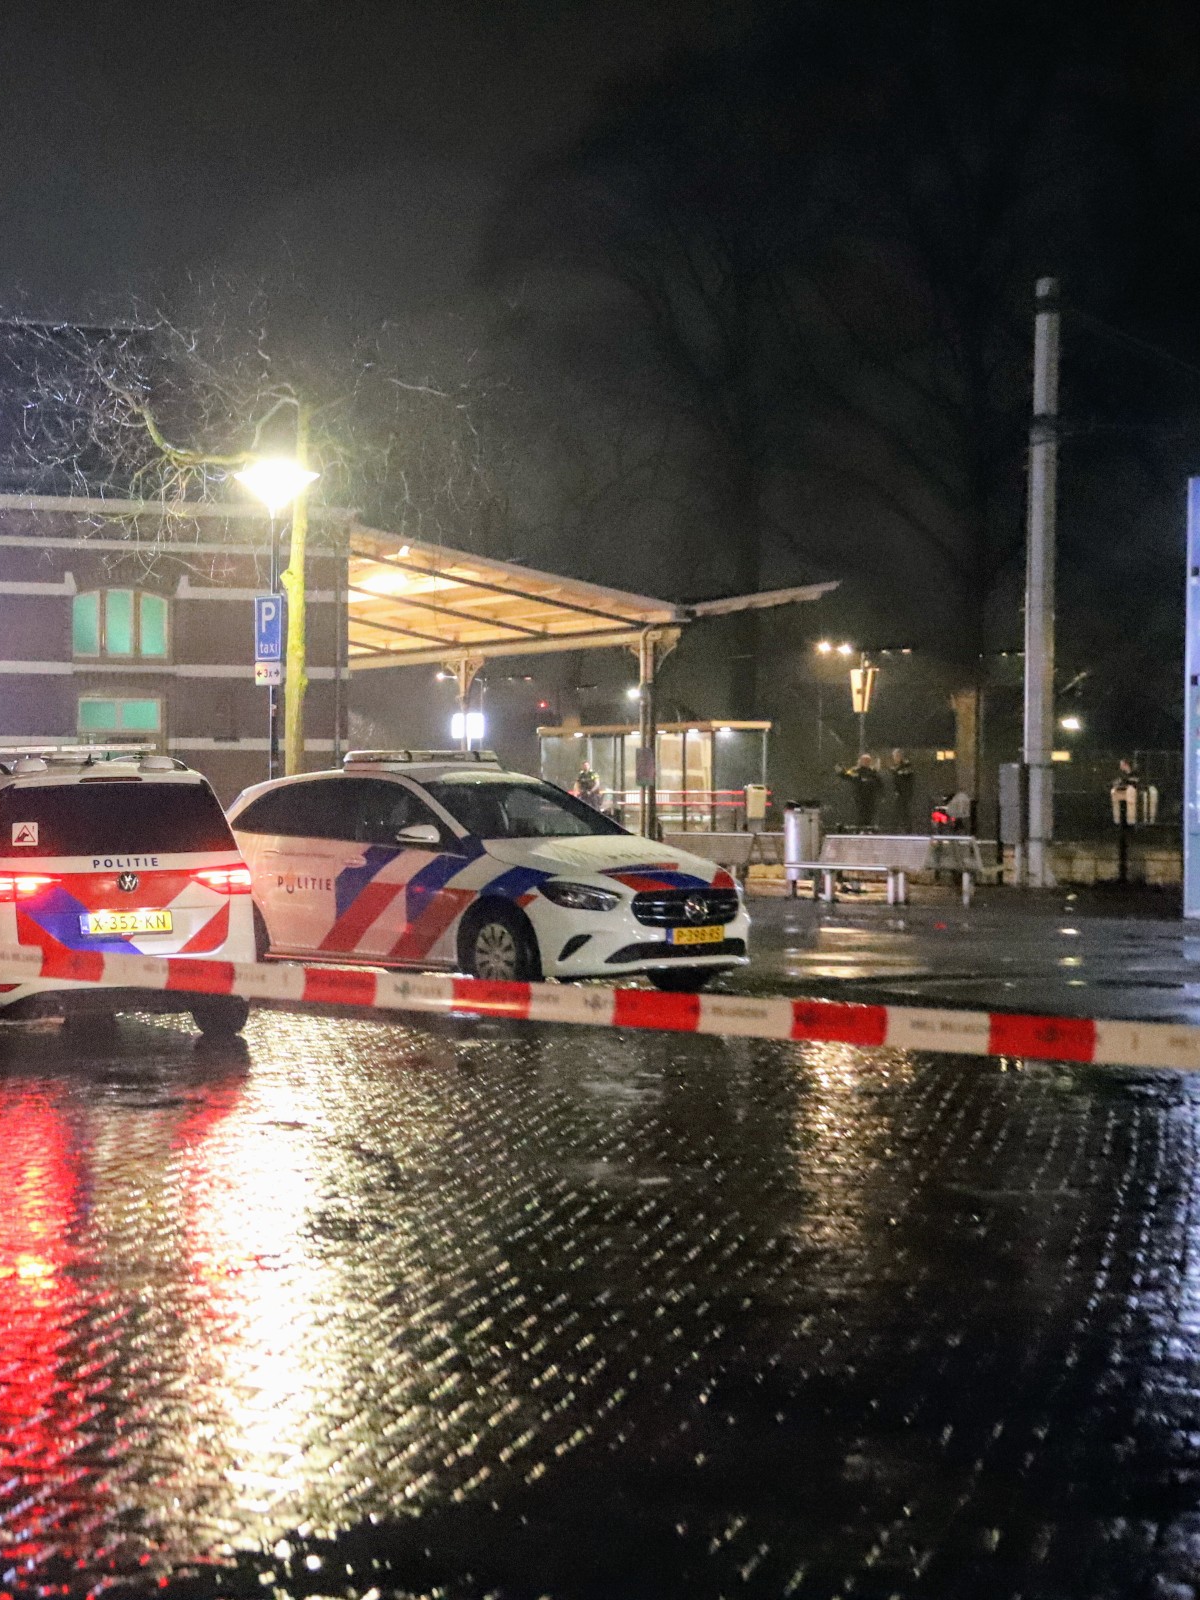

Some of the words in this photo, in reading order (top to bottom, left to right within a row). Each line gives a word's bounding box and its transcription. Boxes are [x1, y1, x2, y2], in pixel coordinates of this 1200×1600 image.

[261, 602, 276, 633] P
[260, 641, 278, 654] taxi
[92, 857, 159, 868] POLITIE
[277, 876, 332, 894] POLITIE
[93, 914, 166, 931] X-352-KN
